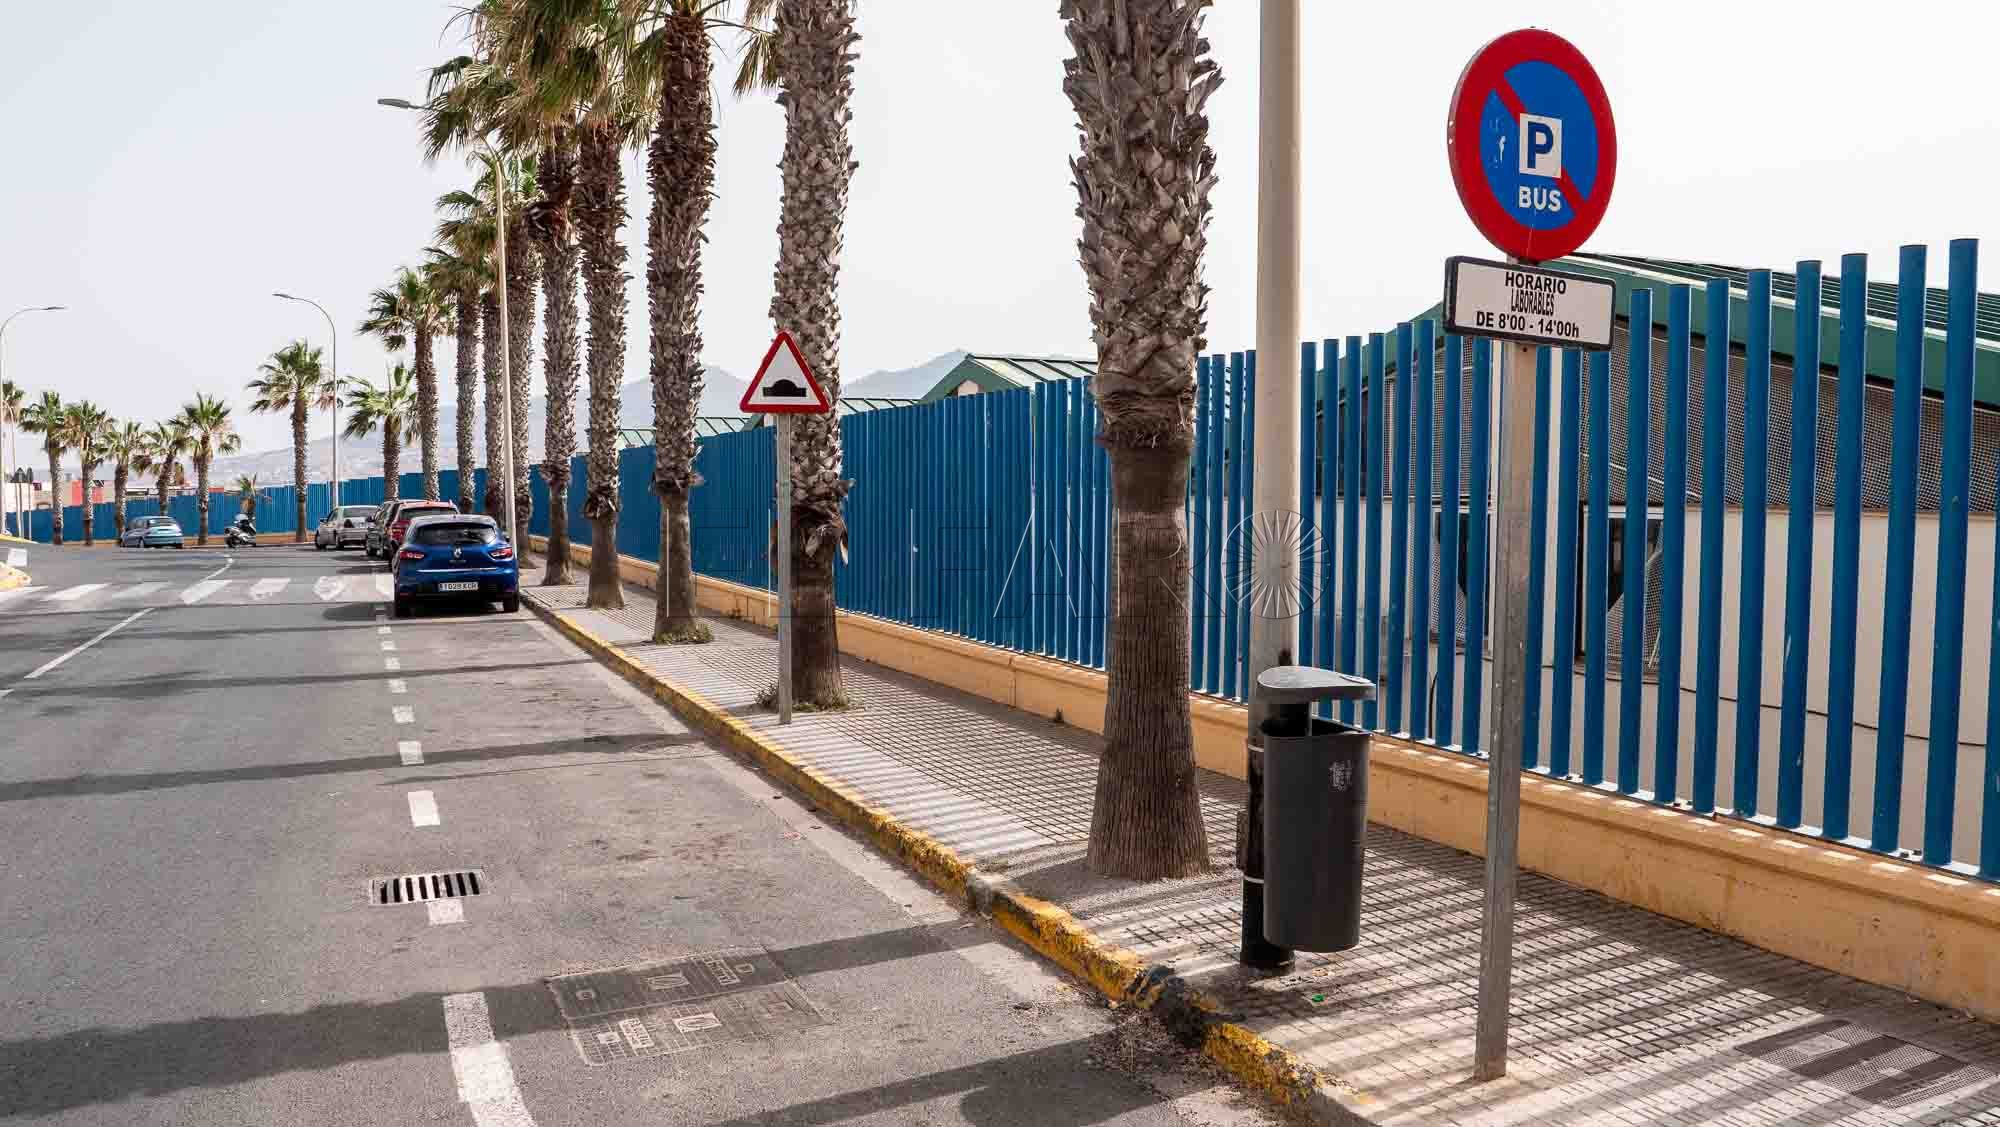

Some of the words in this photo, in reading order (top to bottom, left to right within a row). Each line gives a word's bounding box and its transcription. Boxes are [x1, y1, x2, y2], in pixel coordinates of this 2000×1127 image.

[1527, 121, 1554, 169] P
[1519, 185, 1561, 212] BUS
[1505, 272, 1567, 294] HORARIO
[1511, 289, 1555, 316] LABORABLES
[1476, 311, 1494, 327] DE
[1498, 313, 1526, 331] 8'00
[1537, 318, 1579, 338] 14'00h
